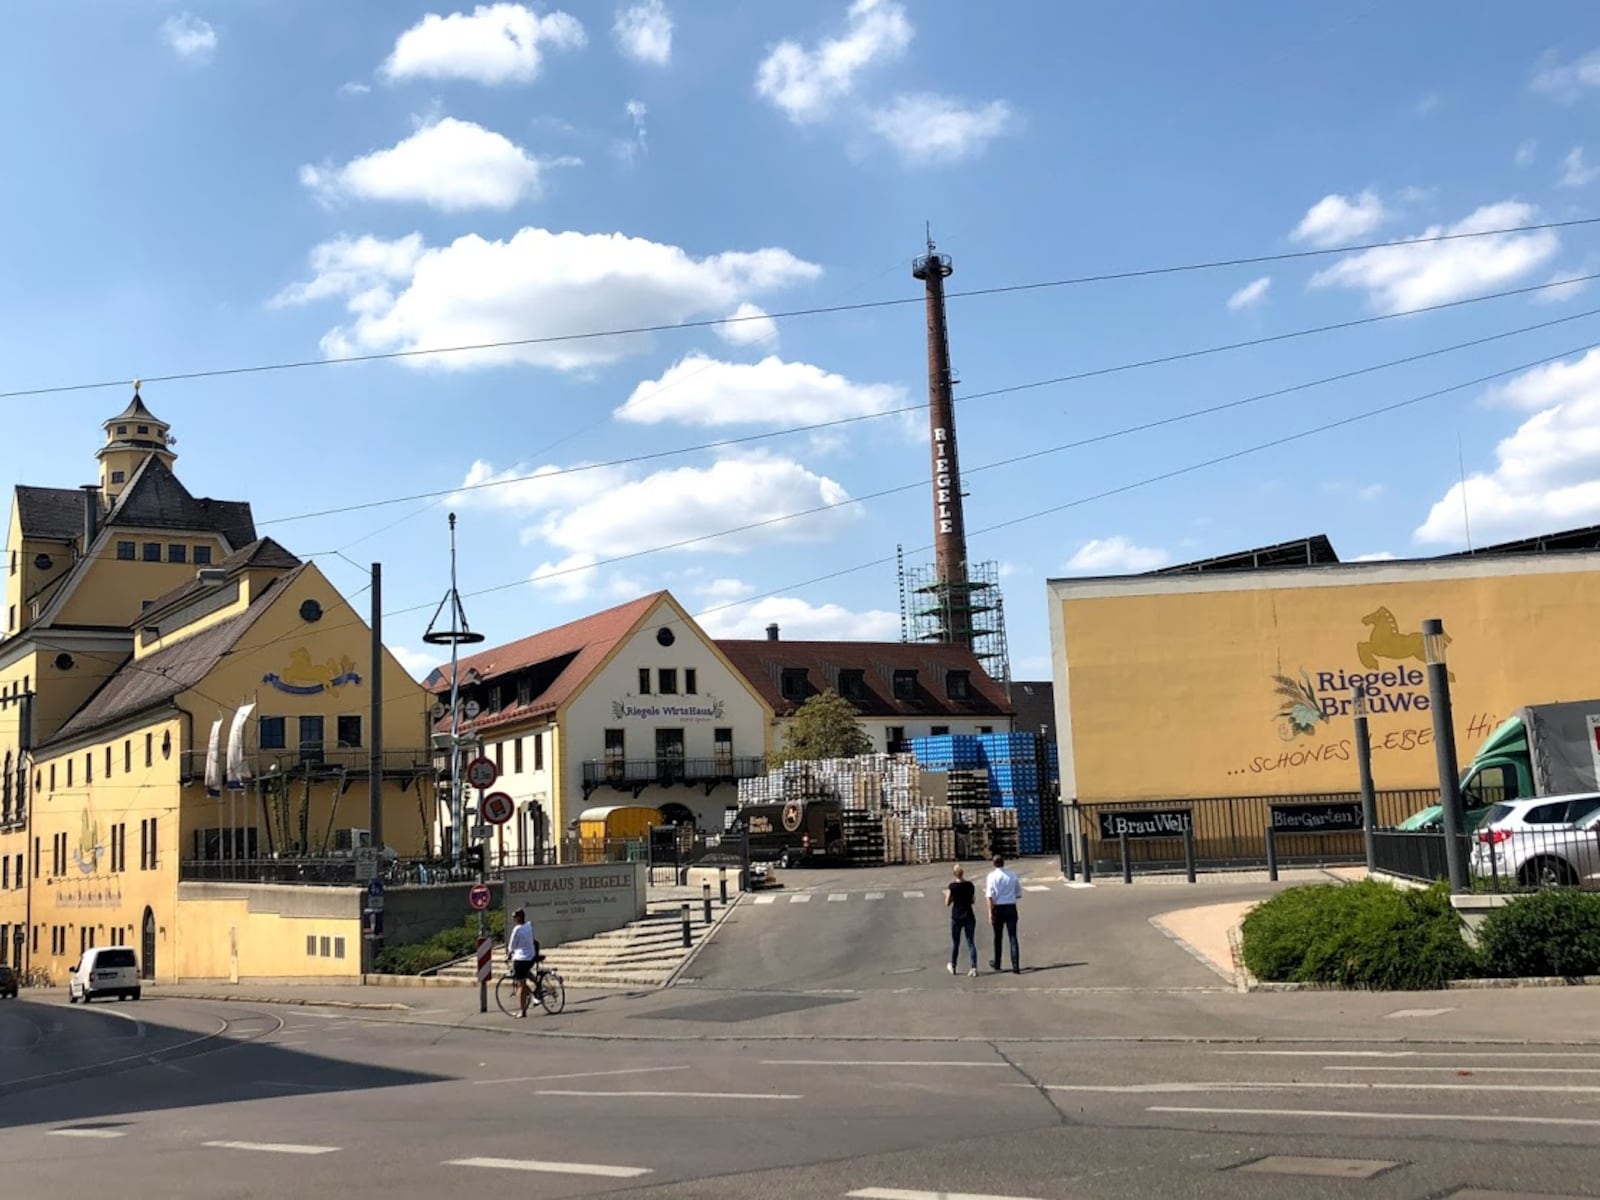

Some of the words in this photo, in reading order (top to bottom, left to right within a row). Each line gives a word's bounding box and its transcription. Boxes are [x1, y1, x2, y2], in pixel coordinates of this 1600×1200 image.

[934, 427, 952, 533] RIEGELE
[1316, 665, 1424, 697] Riegele
[625, 706, 660, 719] Riegele
[1115, 812, 1190, 834] BrauWelt
[1273, 807, 1352, 827] BierGarten
[509, 877, 575, 893] BRAUHAUS
[580, 874, 631, 889] RIEGELE
